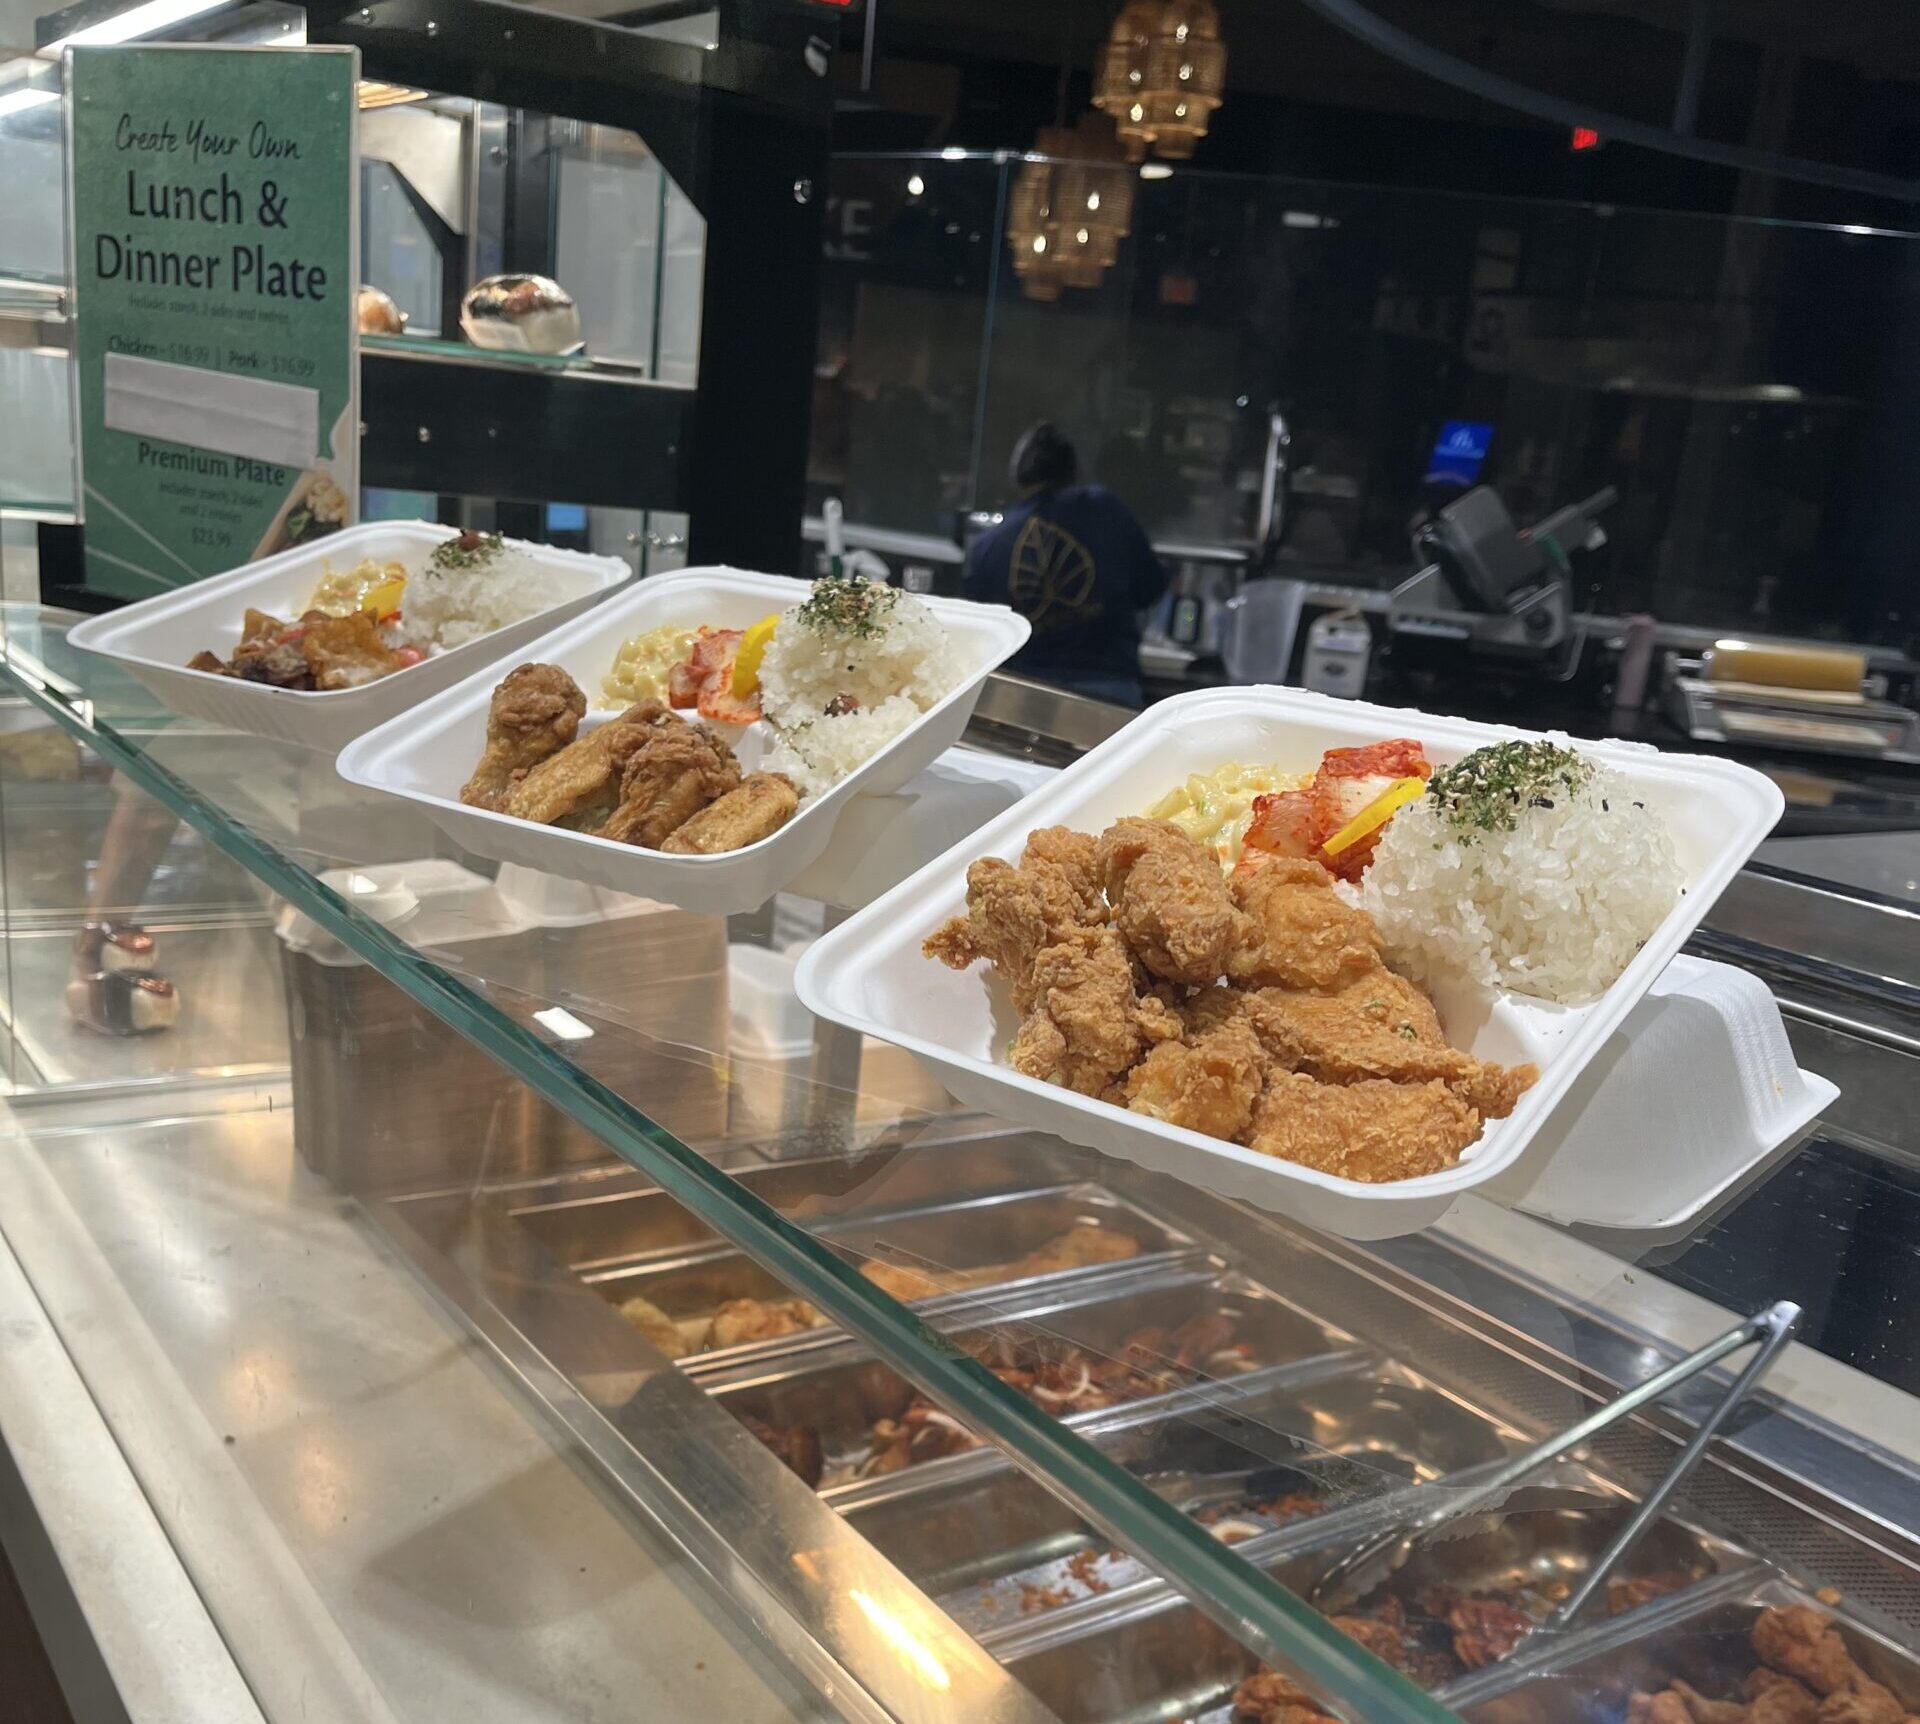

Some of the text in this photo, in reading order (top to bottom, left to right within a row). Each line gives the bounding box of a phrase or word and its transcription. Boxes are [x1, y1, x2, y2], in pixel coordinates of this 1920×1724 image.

[115, 113, 302, 164] Create Your Own
[127, 170, 288, 229] Lunch &
[96, 234, 327, 300] Dinner Plate
[107, 335, 157, 357] Chicken
[228, 351, 259, 368] Pork
[271, 355, 315, 377] $16.99
[138, 442, 285, 486] Premium Plate
[192, 527, 232, 548] $23.99
